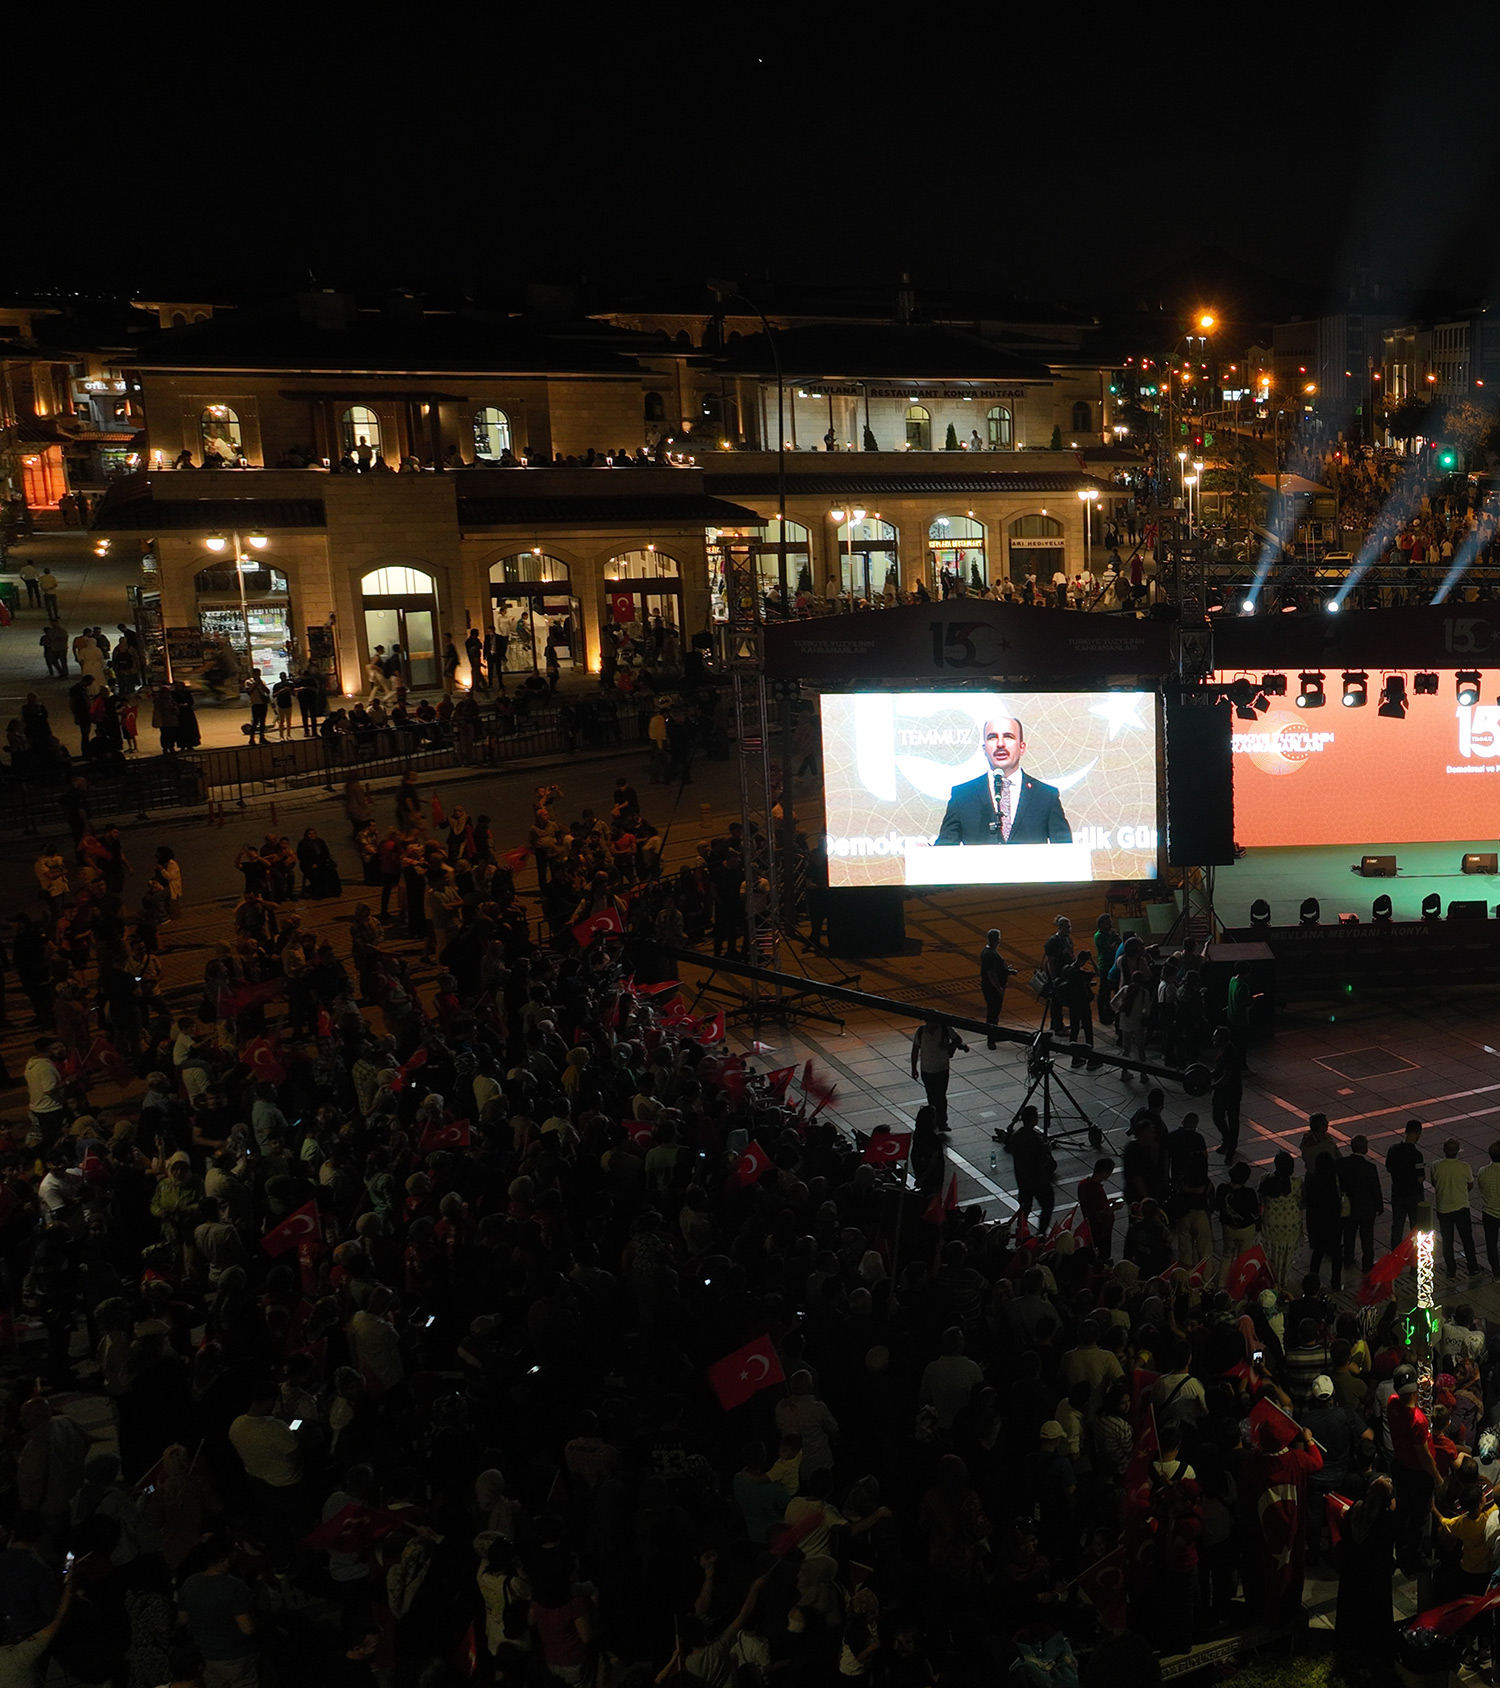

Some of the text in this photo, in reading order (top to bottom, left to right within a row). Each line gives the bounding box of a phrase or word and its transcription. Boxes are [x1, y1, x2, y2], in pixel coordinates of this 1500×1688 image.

[84, 380, 109, 390] OTEL
[808, 385, 858, 395] MEVLANA
[870, 388, 938, 398] RESTAURANT
[943, 388, 978, 398] KONYA
[896, 729, 972, 746] TEMMUZ
[1486, 765, 1495, 773] ve
[1269, 930, 1324, 941] MEVLANA
[1328, 928, 1381, 939] MEYDANI
[1390, 926, 1430, 936] KONYA
